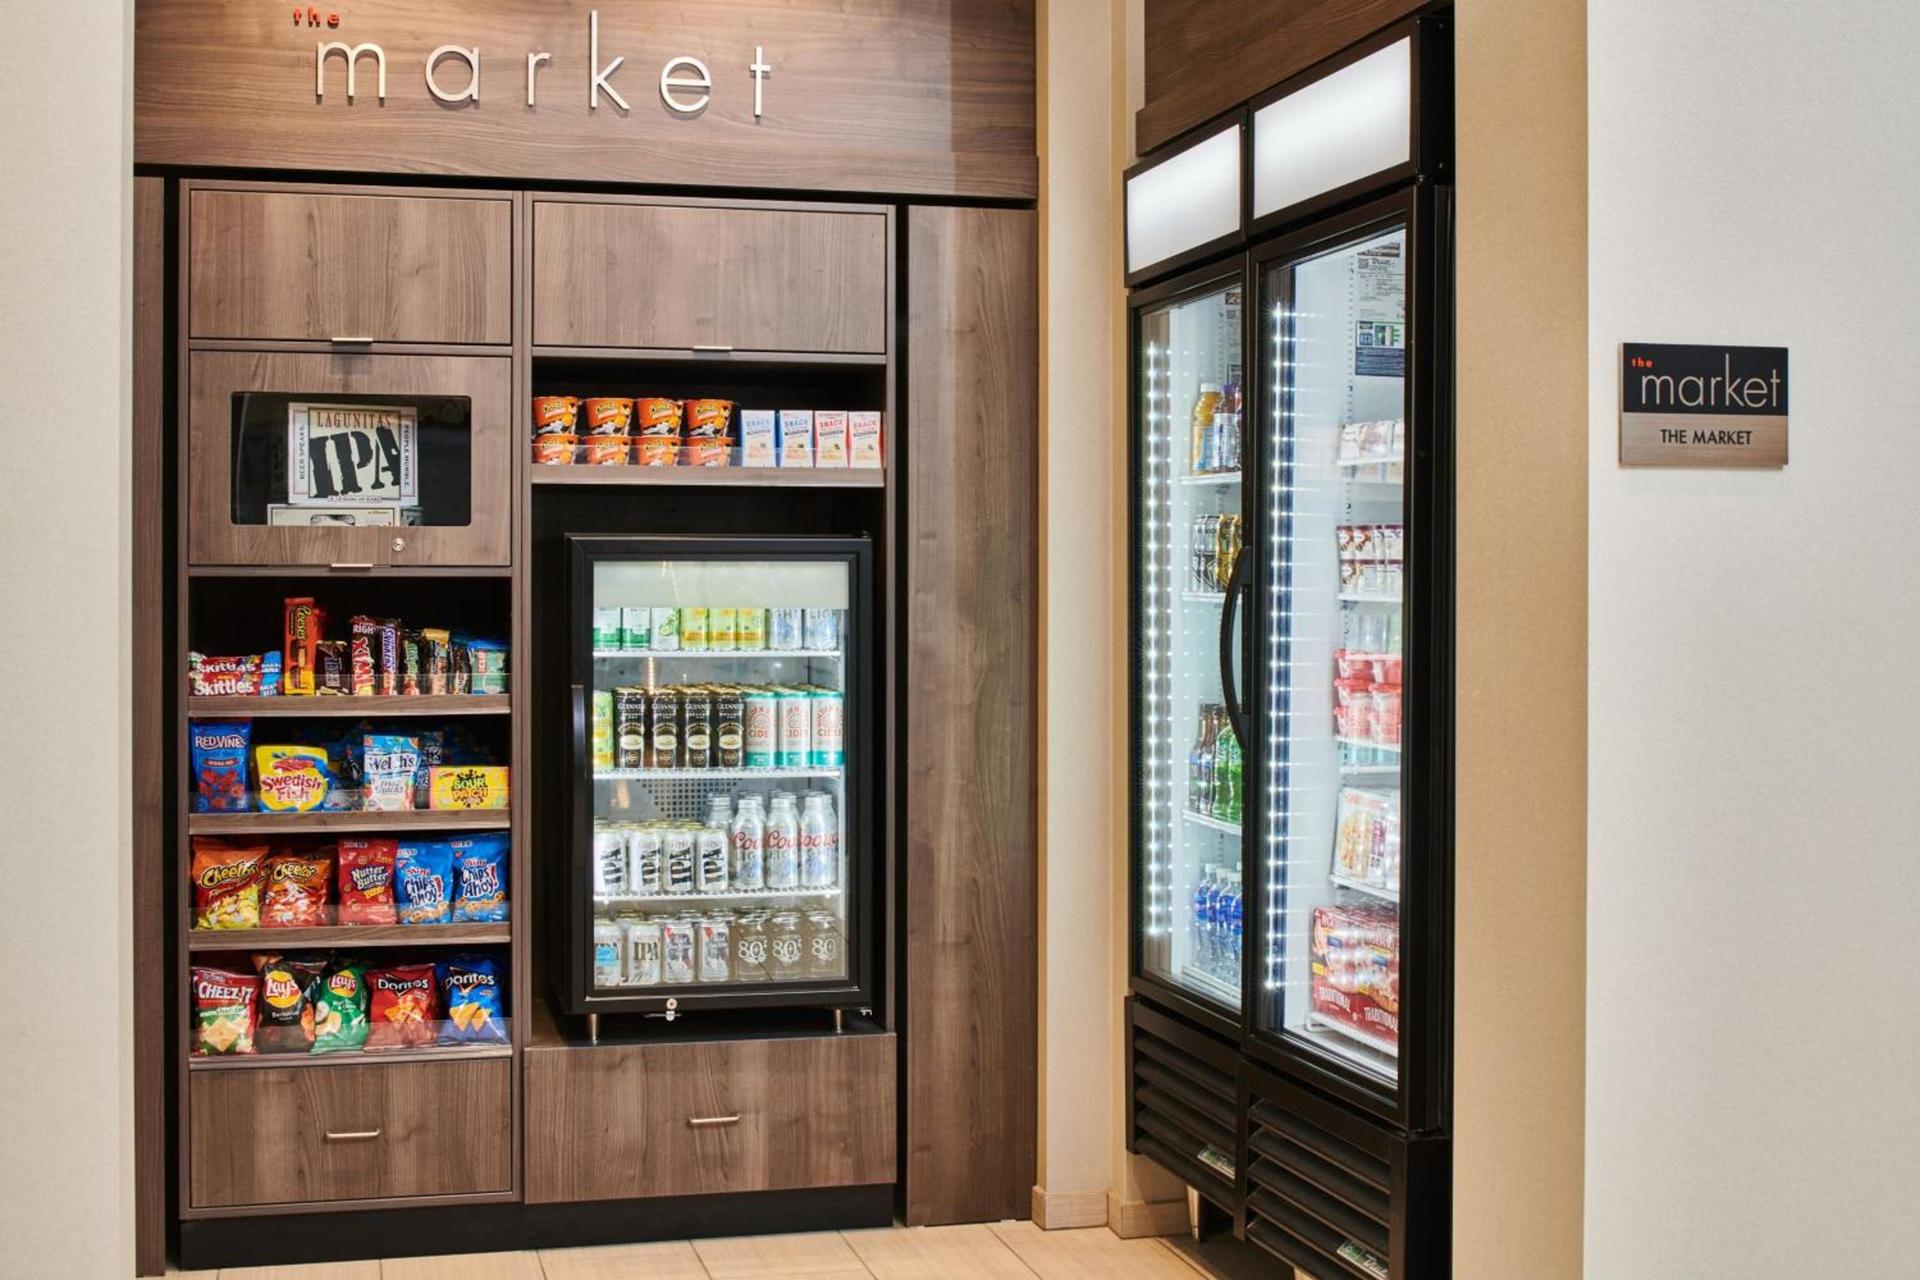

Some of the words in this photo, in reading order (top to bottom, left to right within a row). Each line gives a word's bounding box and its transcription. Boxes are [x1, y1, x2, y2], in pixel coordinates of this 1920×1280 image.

[293, 8, 341, 28] the
[316, 9, 772, 118] market
[1630, 356, 1653, 368] the
[1641, 352, 1781, 408] market
[316, 410, 393, 429] LAGUNITAS
[1660, 428, 1688, 444] THE
[1692, 429, 1754, 446] MARKET
[308, 425, 401, 499] IPA
[193, 679, 255, 697] Skittles
[368, 754, 415, 771] Welh's
[260, 774, 322, 792] Swedish
[453, 777, 487, 789] SOUR
[275, 786, 310, 801] Fish
[272, 862, 317, 883] Cheetos
[351, 866, 385, 882] Nutter
[669, 847, 693, 885] IPA
[356, 873, 388, 891] Butter
[633, 941, 660, 961] IPA
[378, 977, 429, 990] Doritos
[445, 973, 495, 990] Doritos
